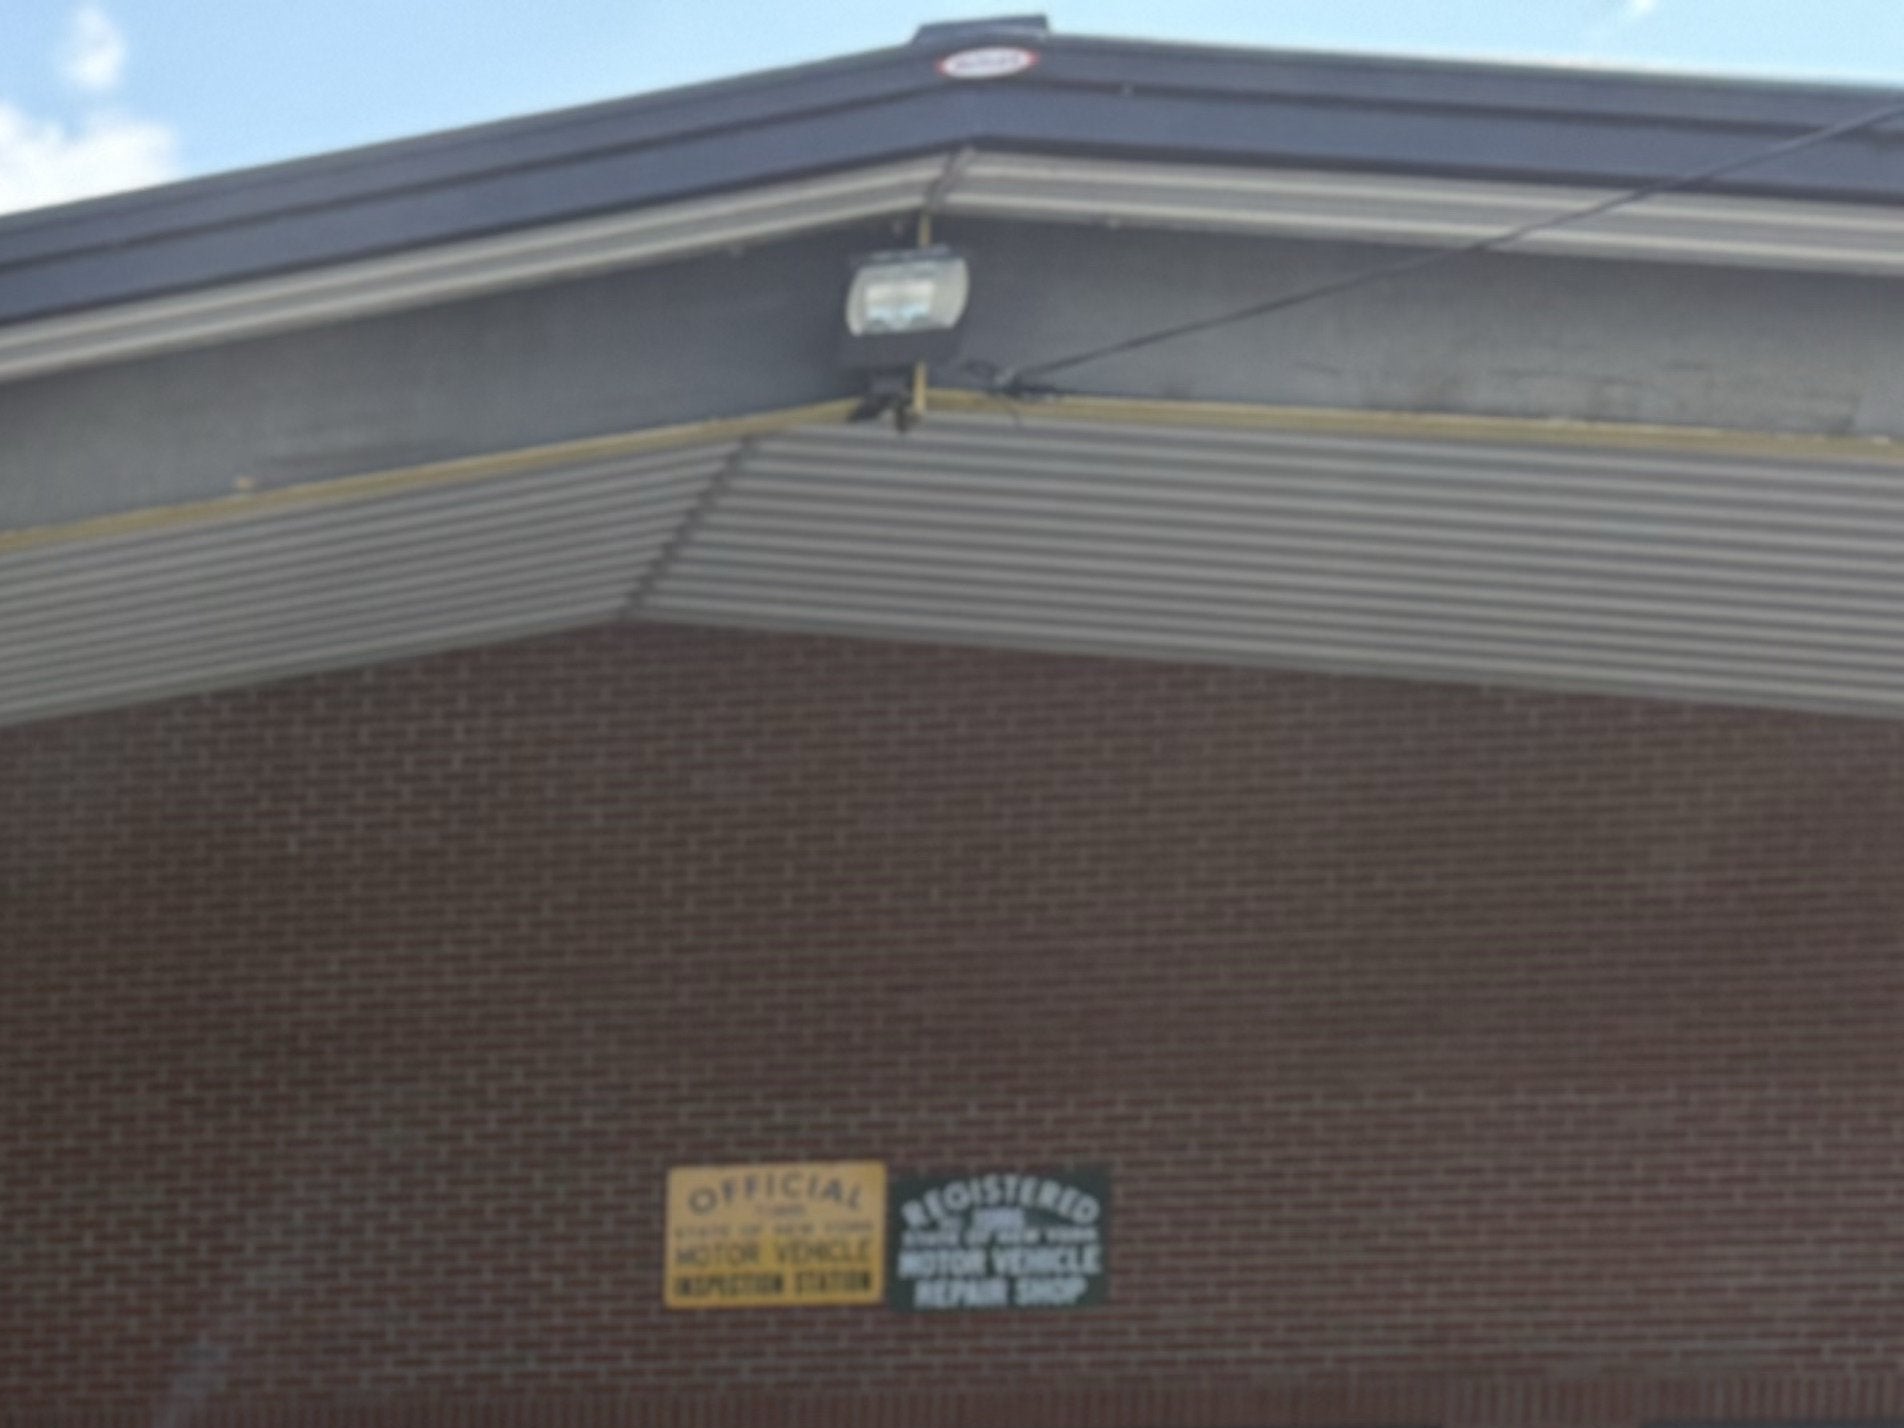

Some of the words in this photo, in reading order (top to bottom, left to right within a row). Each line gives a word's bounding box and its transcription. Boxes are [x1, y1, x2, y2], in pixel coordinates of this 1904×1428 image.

[688, 1169, 863, 1215] OFFICIAL
[901, 1173, 1101, 1227] REGISTERED
[676, 1242, 760, 1266] MOTOR
[770, 1238, 874, 1264] VEHICLE
[897, 1249, 987, 1278] MOTOR
[991, 1245, 1103, 1275] VEHICLE
[676, 1273, 784, 1297] INSPECTION
[795, 1270, 872, 1294] STATION
[913, 1277, 1008, 1309] REPAIR
[1015, 1275, 1089, 1306] SHOP
